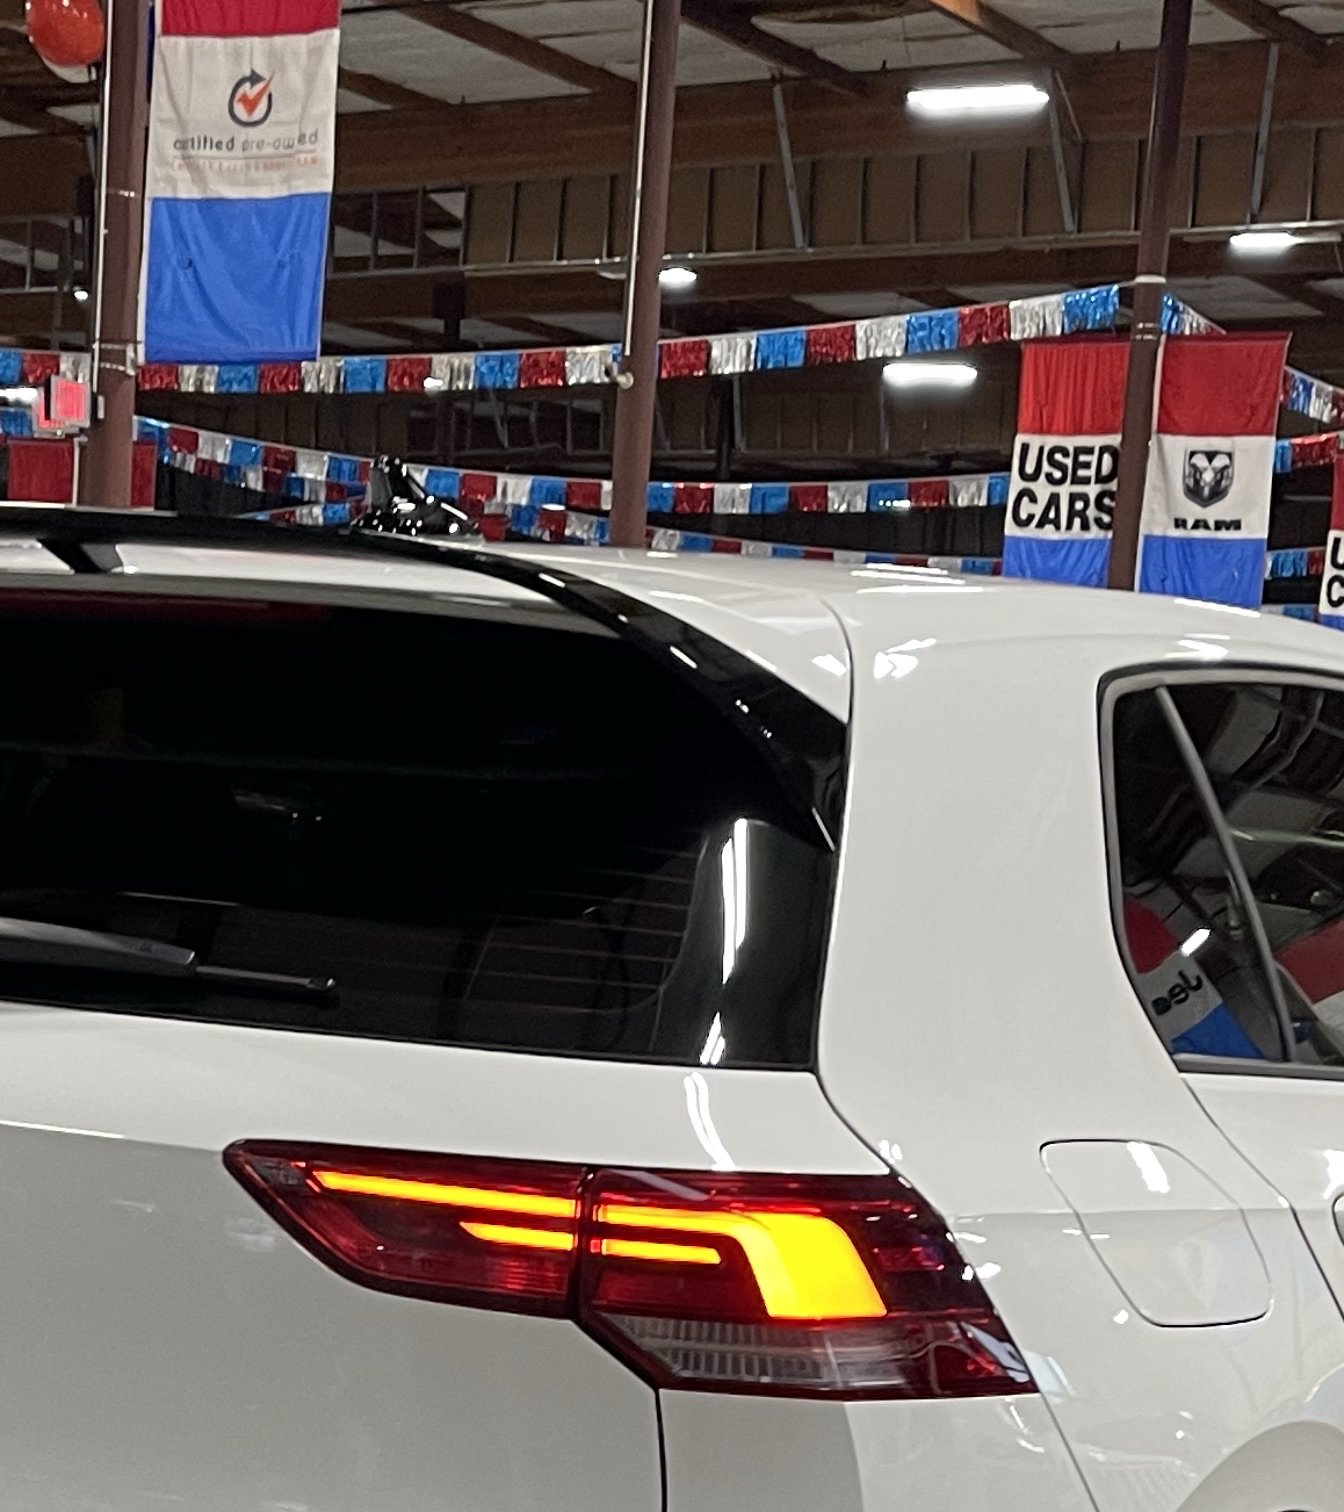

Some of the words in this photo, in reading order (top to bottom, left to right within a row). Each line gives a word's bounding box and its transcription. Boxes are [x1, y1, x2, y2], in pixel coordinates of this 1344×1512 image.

[1018, 442, 1120, 486] USED
[1012, 487, 1116, 531] CARS
[1174, 517, 1242, 531] RAM
